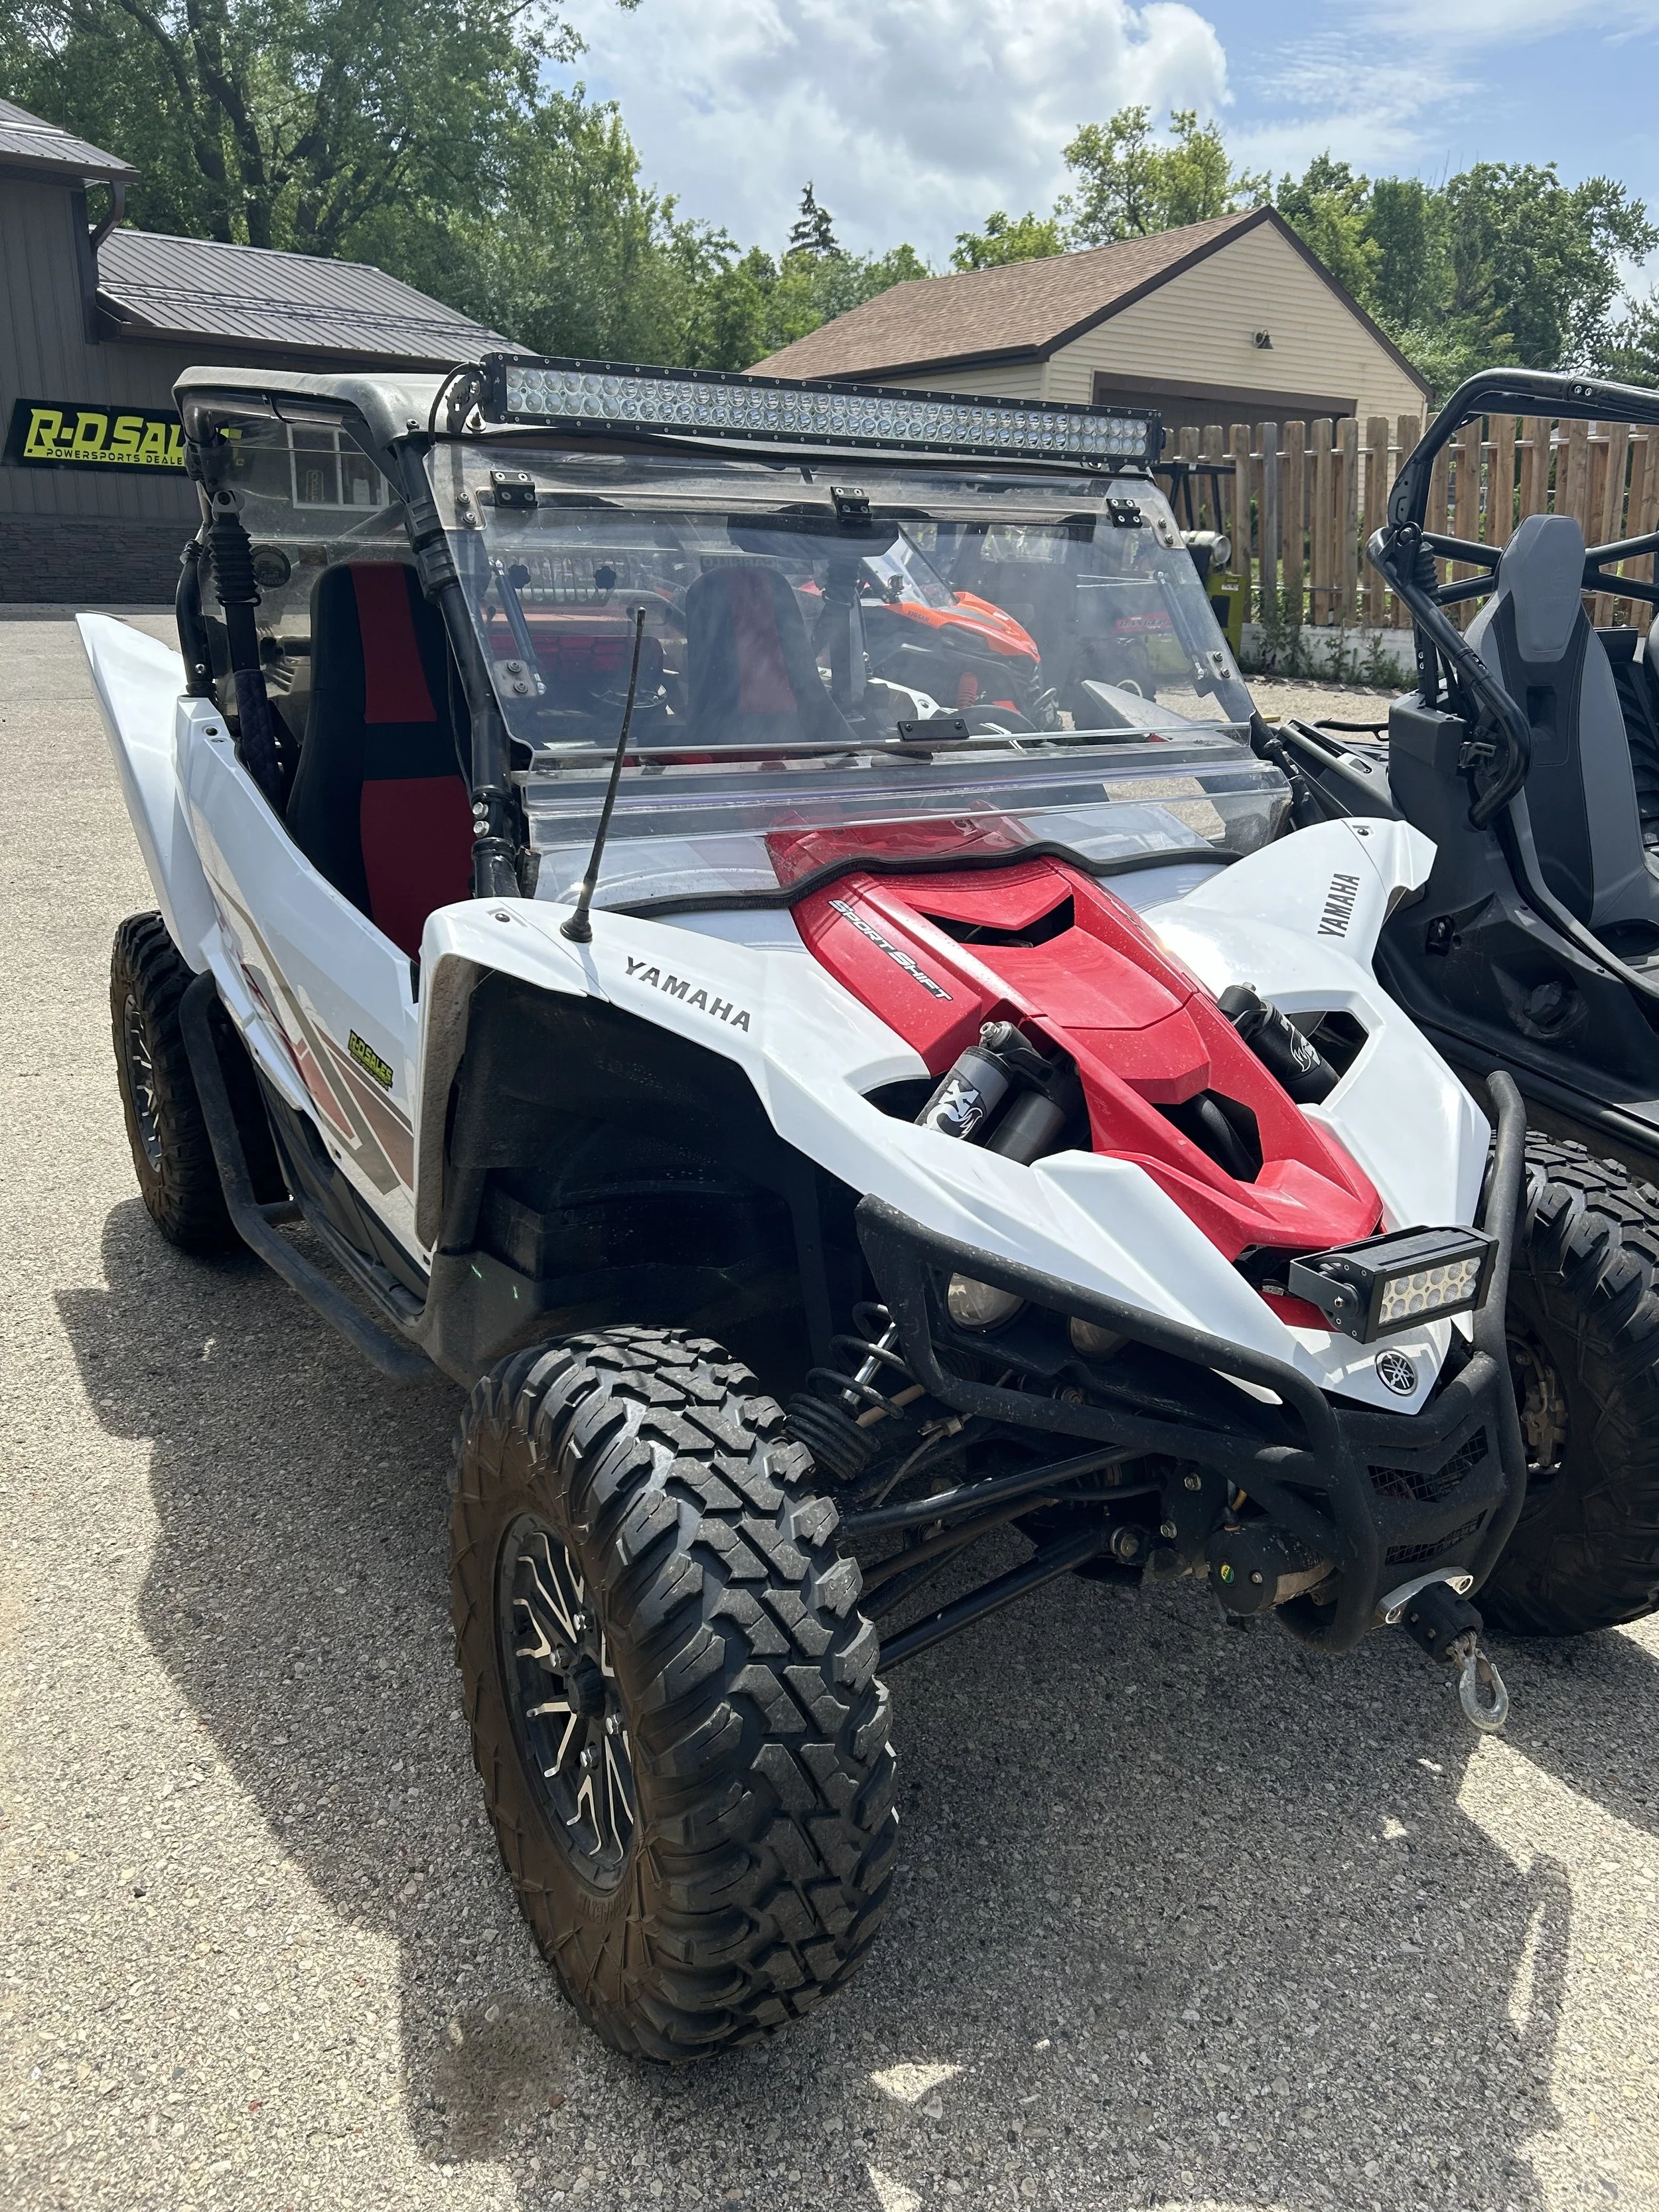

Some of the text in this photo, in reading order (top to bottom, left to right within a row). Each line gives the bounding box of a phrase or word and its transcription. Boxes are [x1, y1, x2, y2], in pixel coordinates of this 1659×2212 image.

[46, 448, 184, 465] POWERSPORTS DEALE
[1317, 873, 1360, 938] YAMAHA
[625, 956, 751, 1033] YAMAHA
